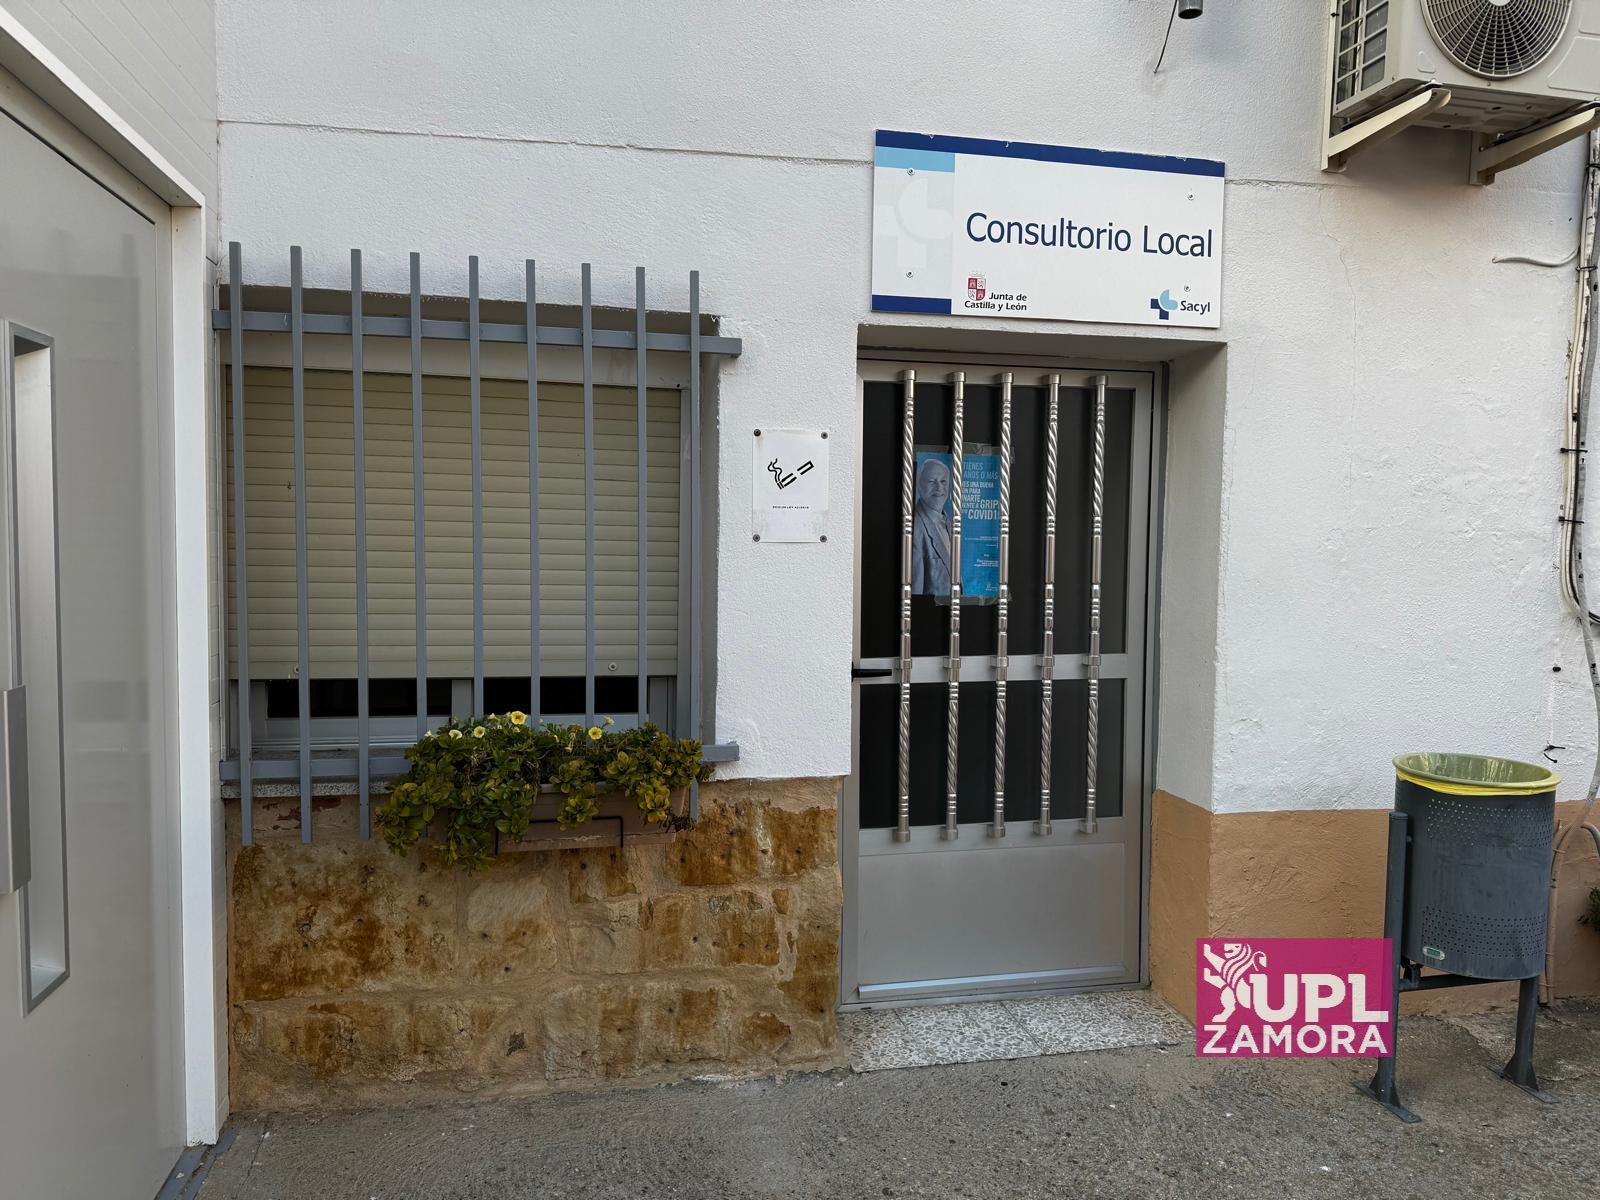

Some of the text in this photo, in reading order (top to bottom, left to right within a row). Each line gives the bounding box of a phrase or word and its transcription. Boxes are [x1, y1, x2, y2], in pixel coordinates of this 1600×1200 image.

[966, 212, 1212, 258] Consultorio Local
[988, 292, 1028, 302] Junta de
[964, 300, 1027, 312] Castilla y León
[1180, 300, 1211, 315] Sacyl
